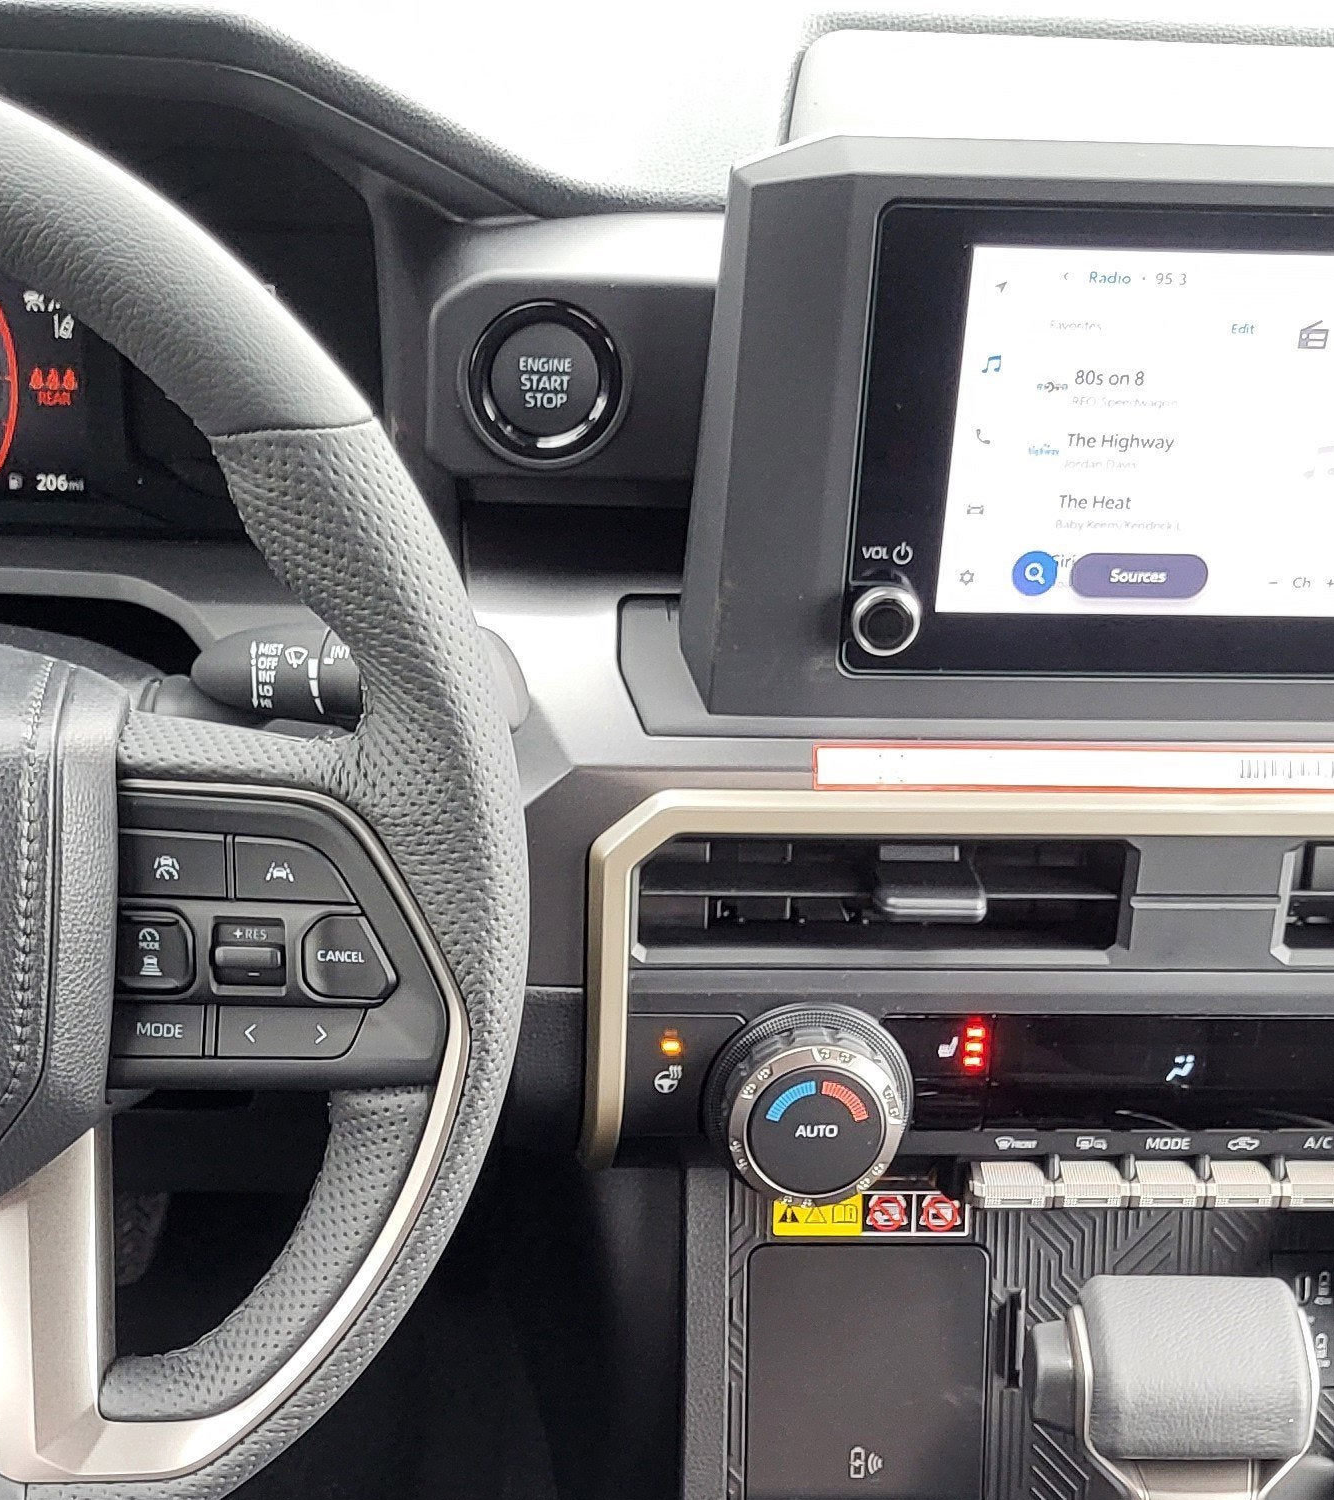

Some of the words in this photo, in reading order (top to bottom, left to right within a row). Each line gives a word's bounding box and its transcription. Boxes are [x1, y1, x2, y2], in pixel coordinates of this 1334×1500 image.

[1088, 270, 1131, 285] Radio
[1155, 271, 1188, 286] 953
[1231, 323, 1256, 335] Edit
[519, 356, 573, 373] ENGINE
[520, 373, 572, 391] START
[1074, 369, 1103, 386] 80s
[1108, 374, 1130, 386] on
[1134, 370, 1145, 386] 8
[524, 392, 569, 409] STOP
[1067, 432, 1096, 448] The
[1101, 433, 1175, 453] Highway
[1058, 494, 1088, 511] The
[1092, 495, 1132, 511] Heat
[862, 545, 890, 560] VOL
[1109, 567, 1168, 584] Sources
[1291, 576, 1312, 590] Ch
[258, 642, 285, 657] MIST
[258, 657, 279, 670] OFF
[258, 670, 276, 684] INT
[258, 683, 274, 697] LO
[316, 949, 365, 964] CANCEL
[136, 1021, 184, 1038] MODE
[794, 1123, 840, 1139] AUTO
[1145, 1136, 1192, 1151] MODE
[1303, 1135, 1334, 1150] A/C
